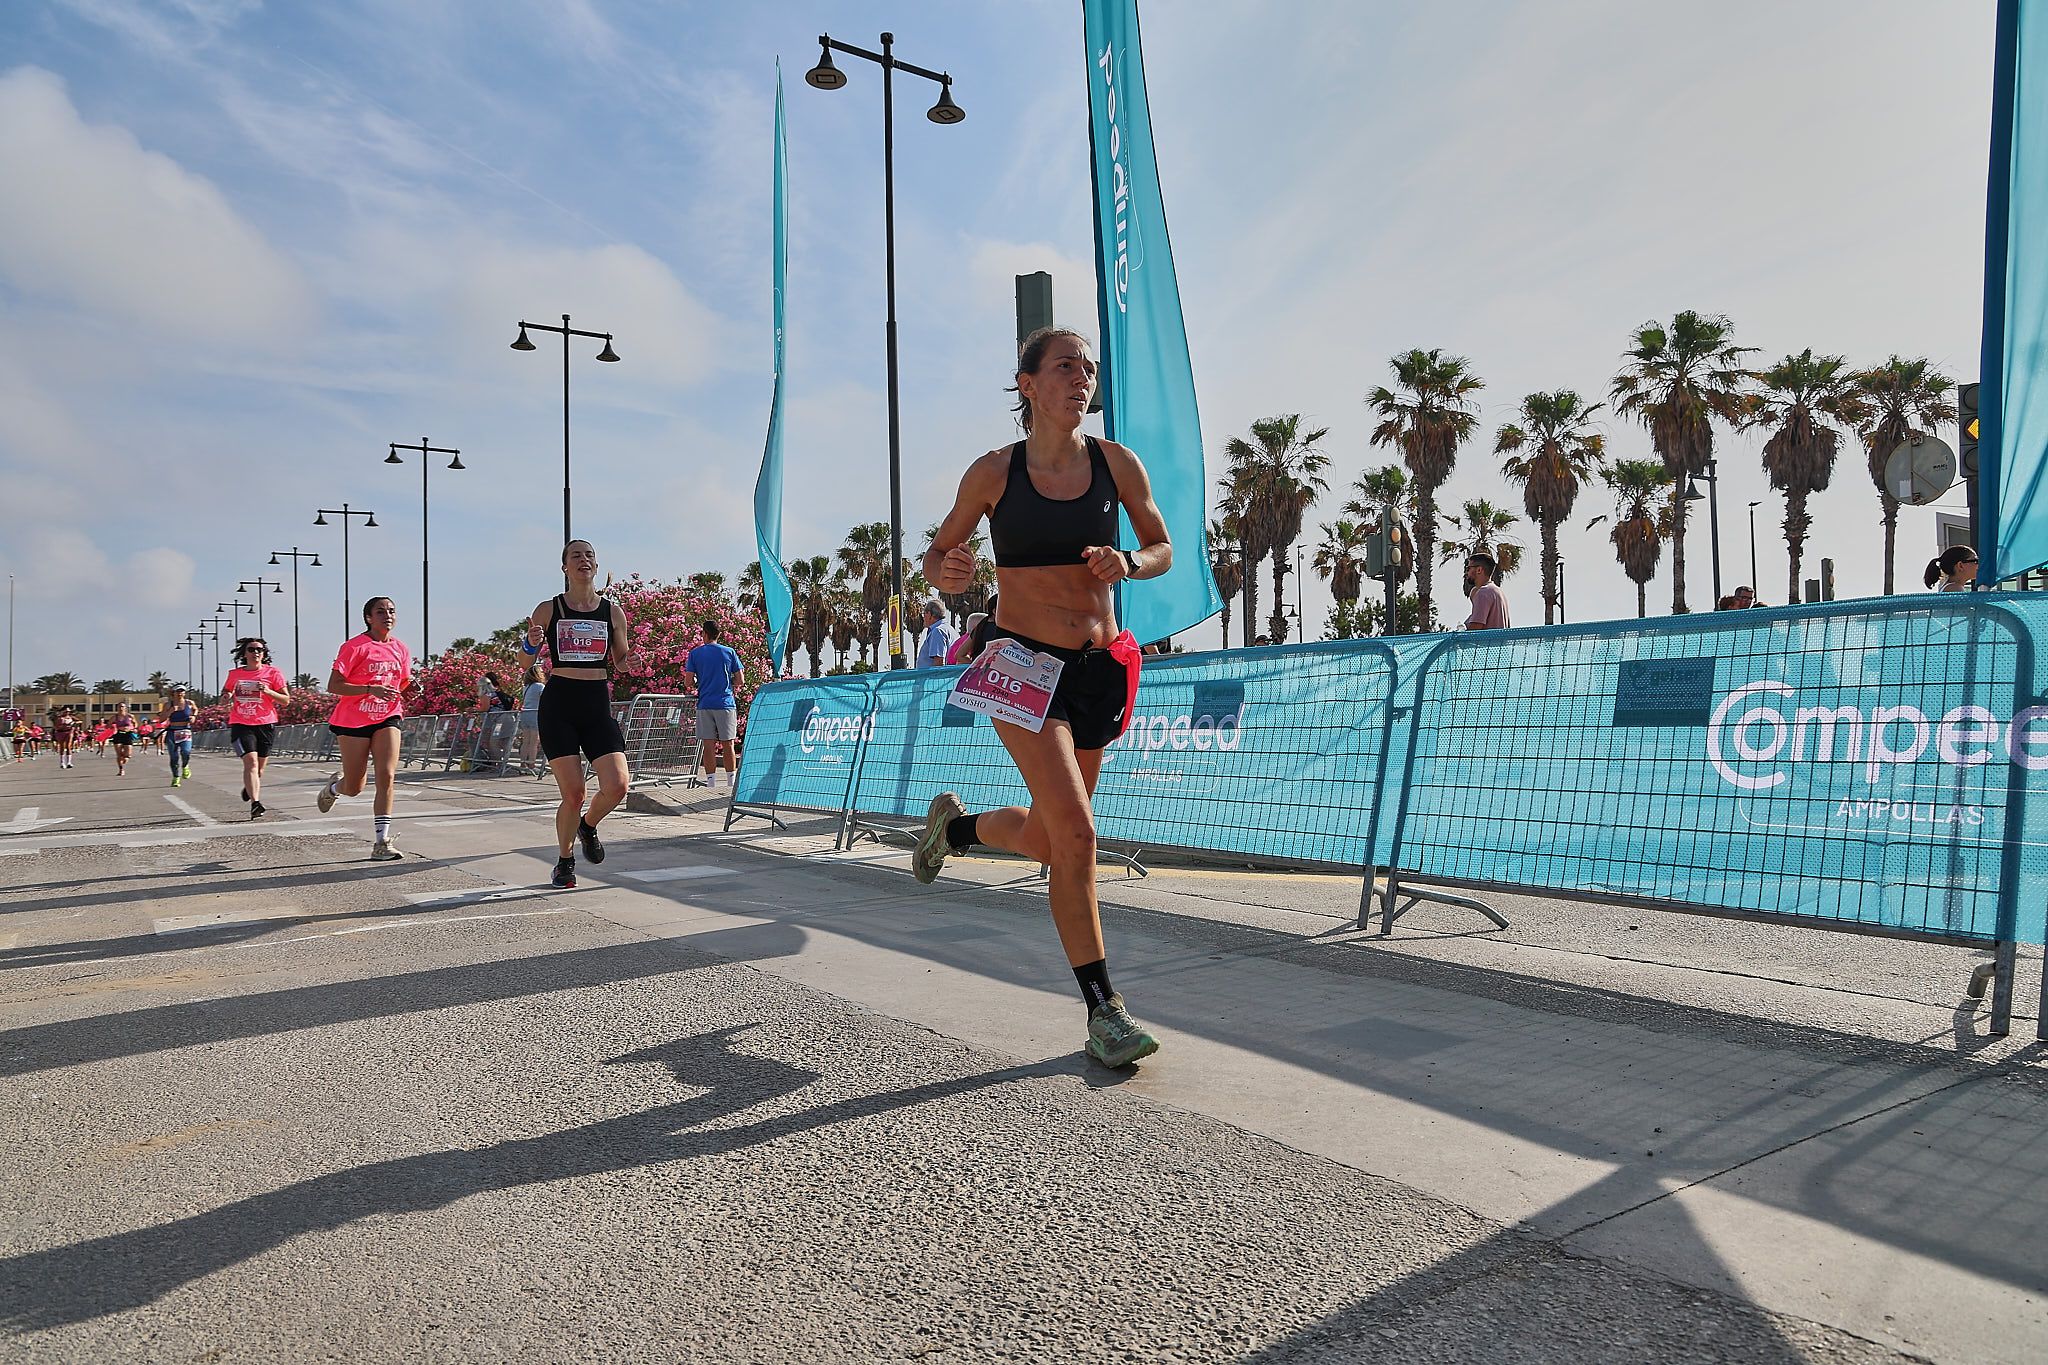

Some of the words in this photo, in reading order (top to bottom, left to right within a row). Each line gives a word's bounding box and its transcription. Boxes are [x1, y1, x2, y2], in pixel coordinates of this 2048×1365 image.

[987, 670, 1023, 693] 016
[359, 699, 389, 713] MUJER
[959, 697, 987, 709] OYSHO
[962, 687, 981, 697] CARRERA
[1014, 702, 1036, 715] VALENCIA
[1003, 707, 1032, 724] Santander
[801, 706, 879, 754] Compeed
[1101, 702, 1245, 764] mpeed
[1130, 768, 1183, 783] AMPOLLAS
[1836, 796, 1985, 826] AMPOLLAS
